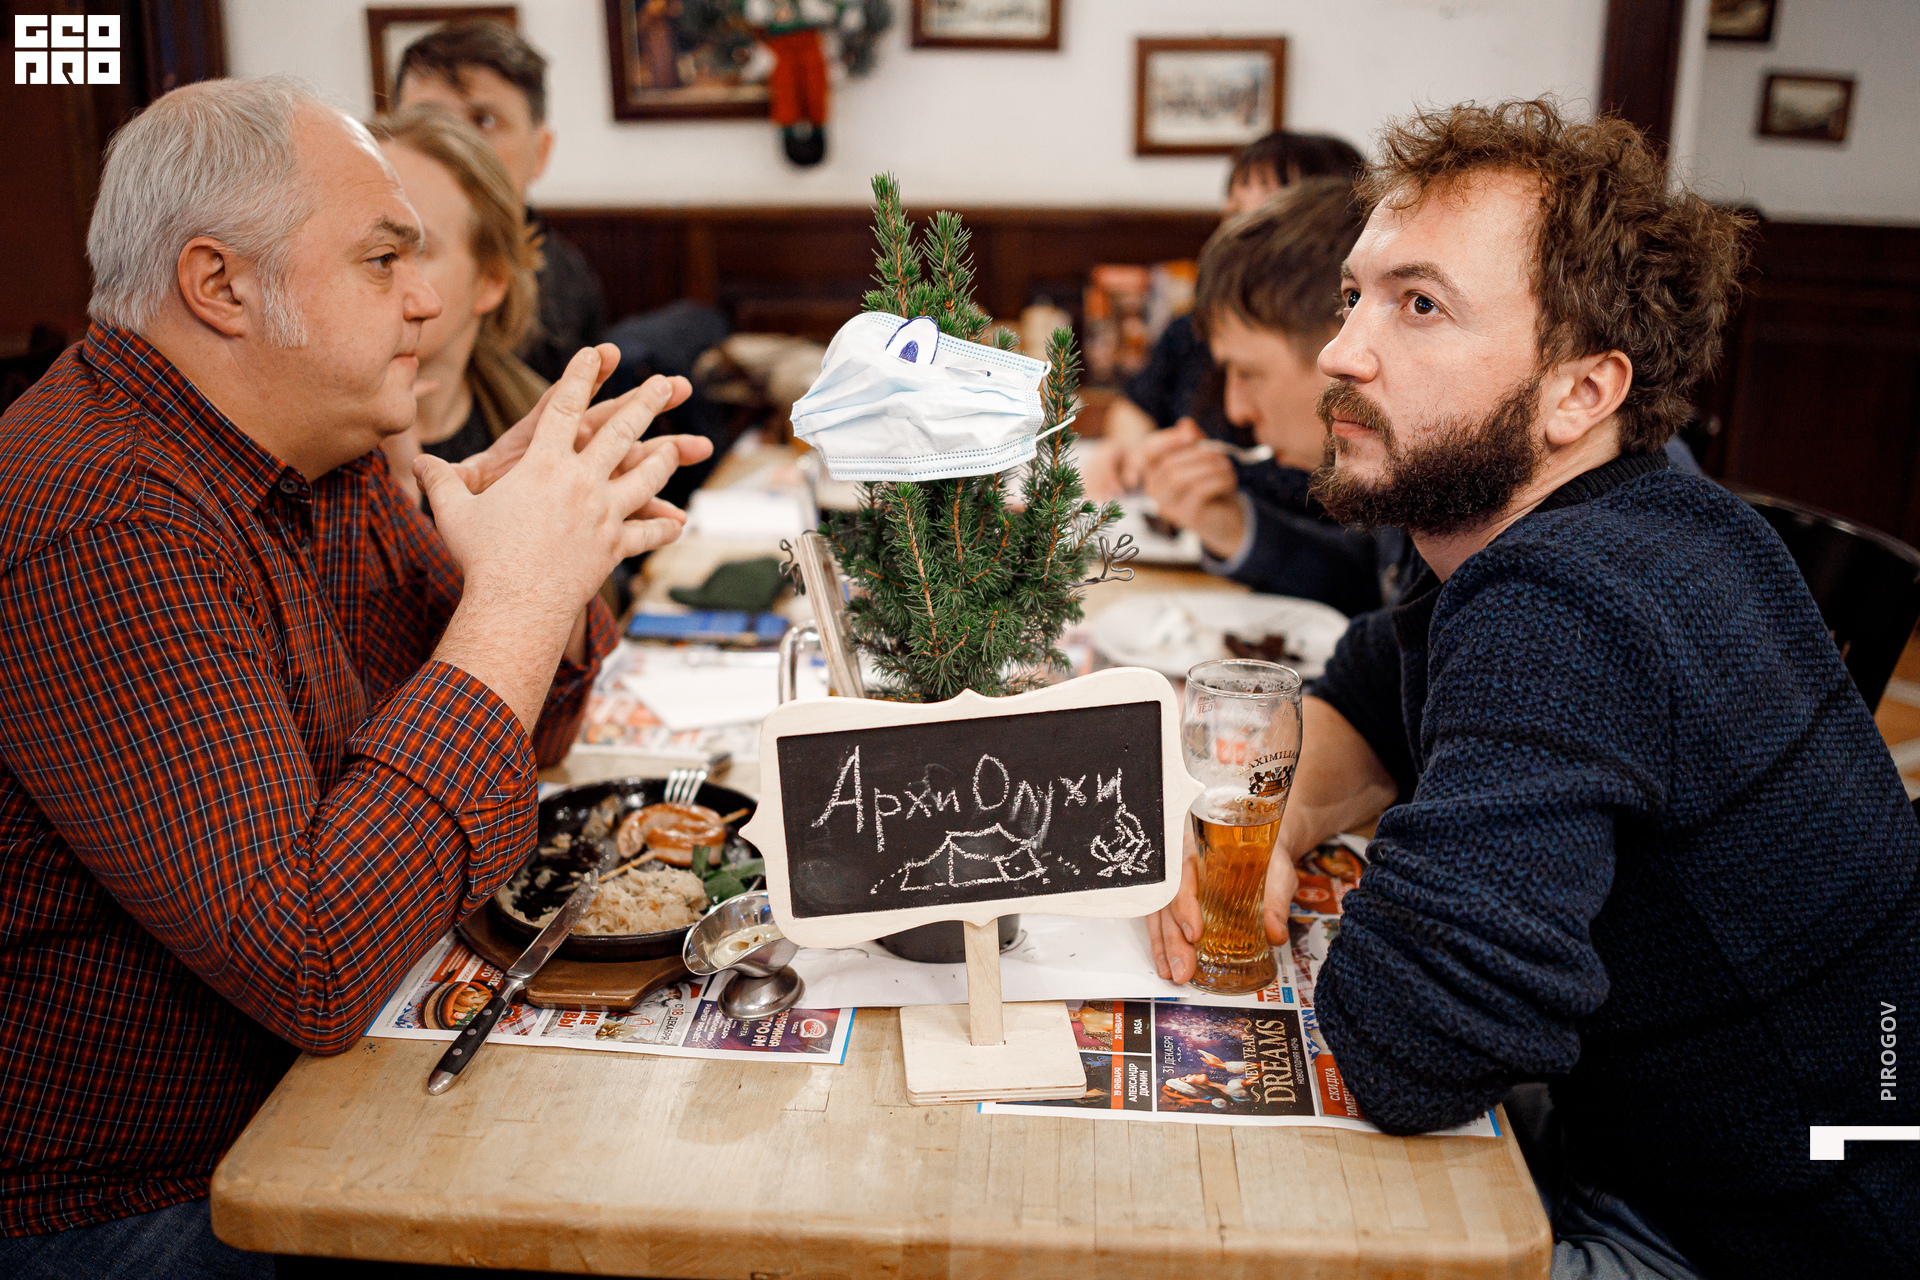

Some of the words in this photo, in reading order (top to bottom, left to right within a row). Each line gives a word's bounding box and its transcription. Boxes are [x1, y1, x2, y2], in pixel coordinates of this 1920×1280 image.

[1235, 750, 1298, 775] MAXIMILIA
[671, 1008, 684, 1016] 18
[1114, 1012, 1123, 1034] ЯНВАРЯ
[661, 1015, 678, 1041] ДЕКАБРЯ
[1133, 1018, 1143, 1035] RASA
[1163, 1035, 1177, 1065] ДЕКАБРЯ
[1241, 1033, 1257, 1059] YEAR
[1290, 1037, 1300, 1051] НОЧЬ
[1162, 1065, 1175, 1074] 31
[1244, 1061, 1261, 1085] NEW
[1255, 1018, 1297, 1105] DREAMS
[1113, 1067, 1122, 1089] ЯНВАРЯ
[1128, 1063, 1139, 1102] АЛЕКСАНДР
[1139, 1070, 1150, 1097] ДЮМИН
[1325, 1067, 1341, 1102] СКИДКА
